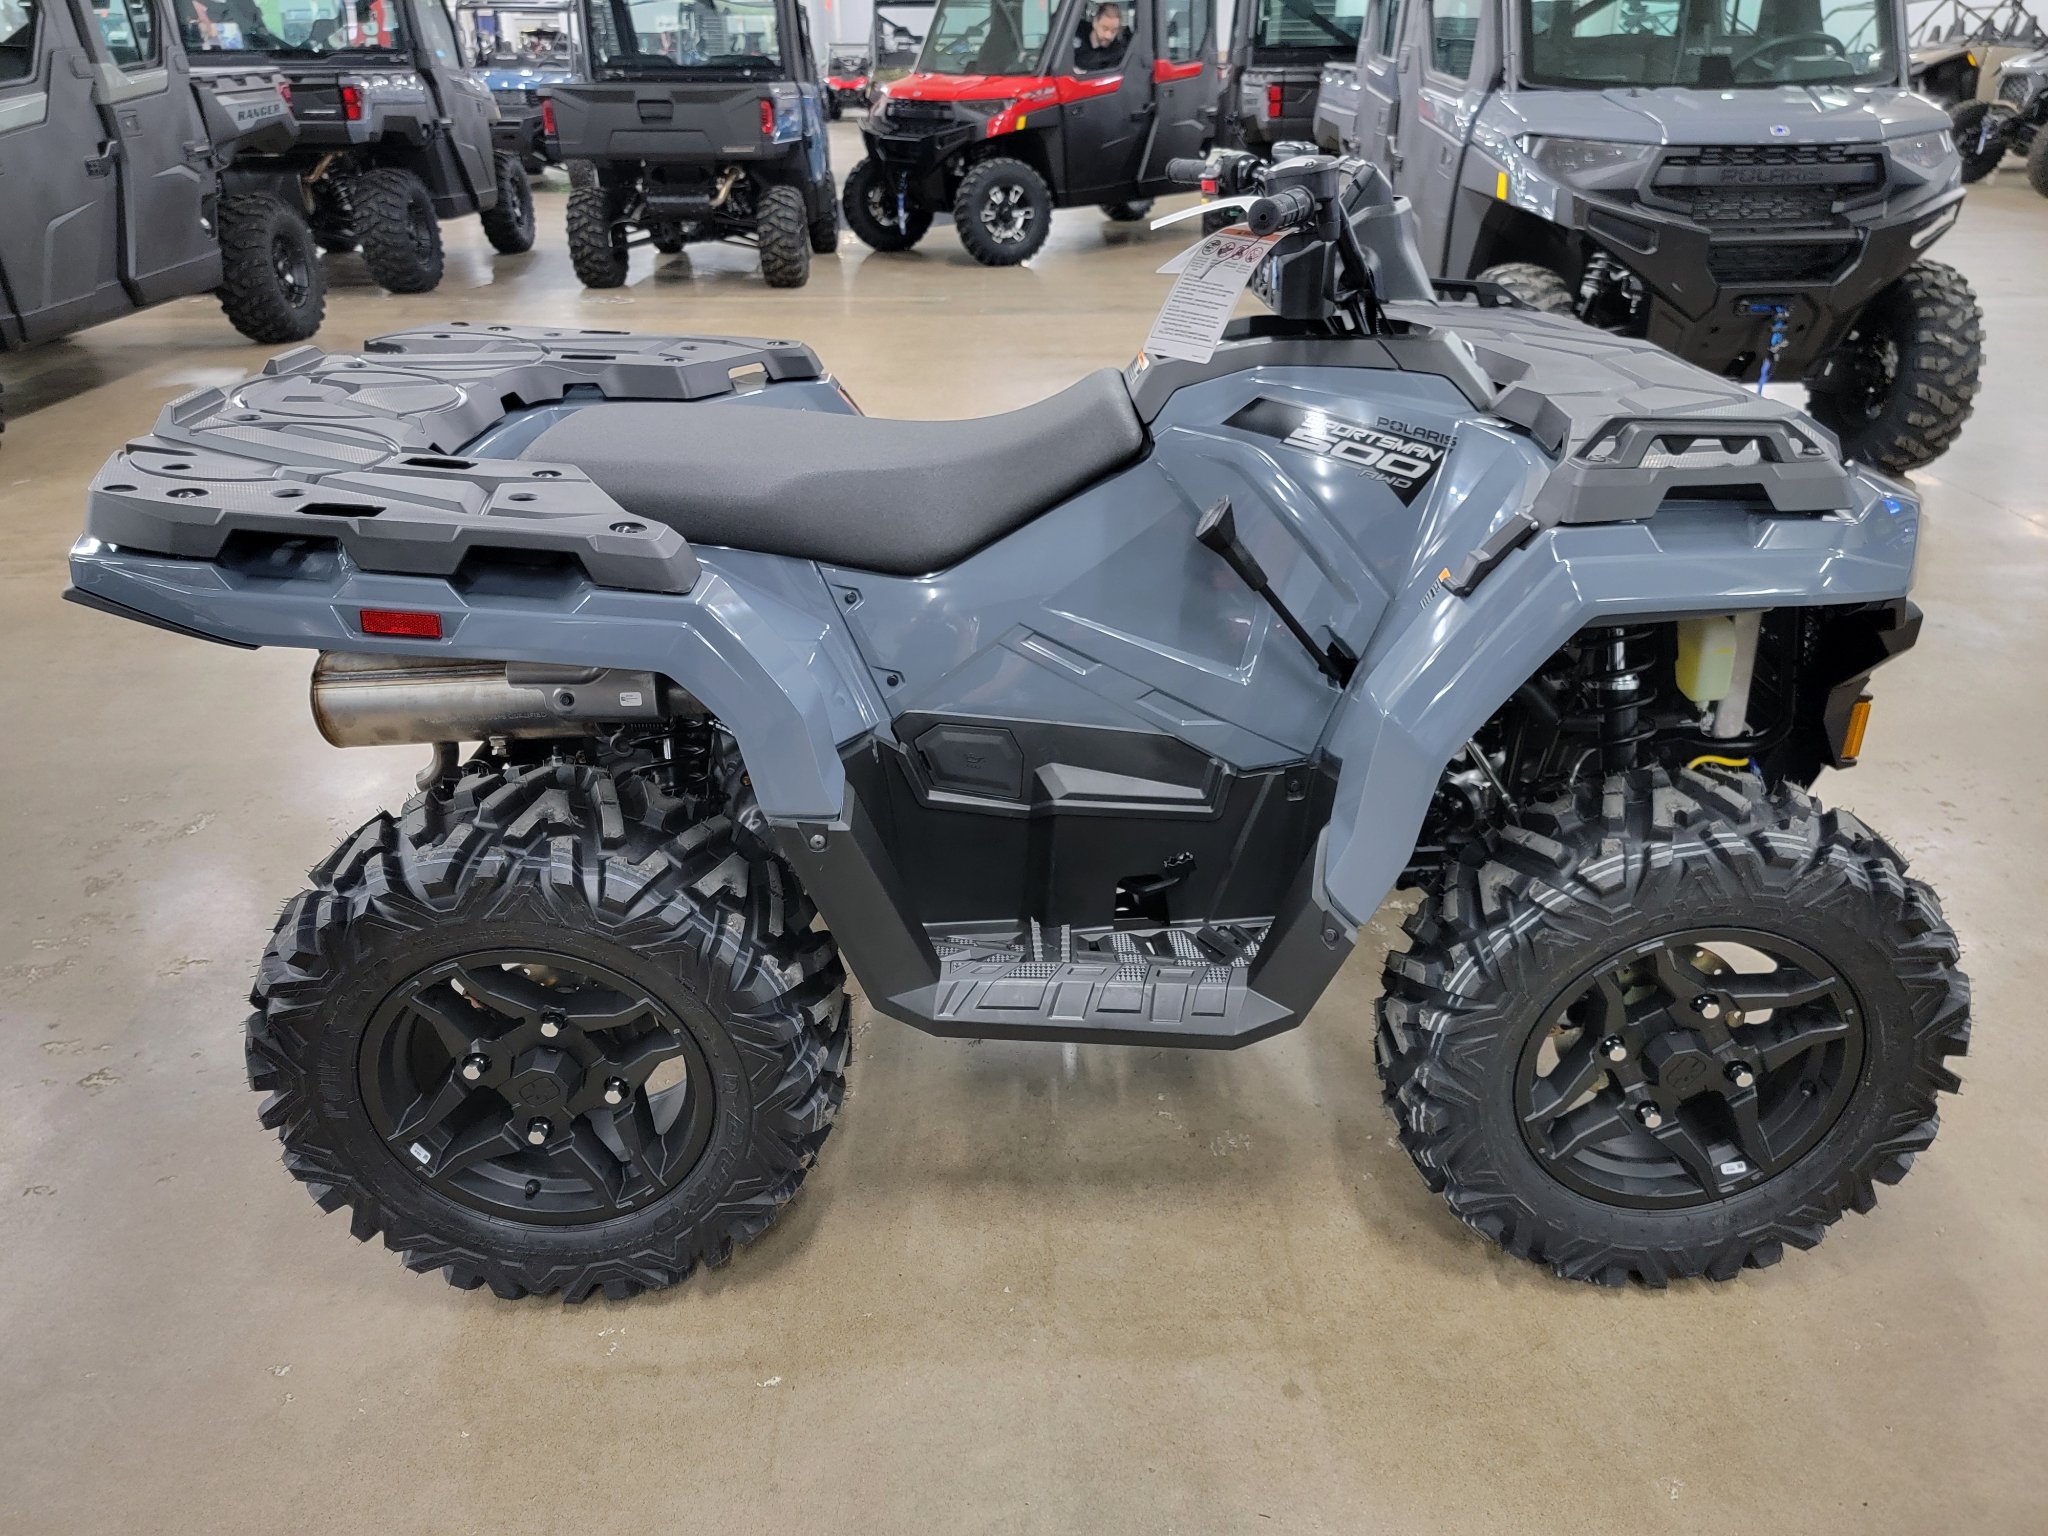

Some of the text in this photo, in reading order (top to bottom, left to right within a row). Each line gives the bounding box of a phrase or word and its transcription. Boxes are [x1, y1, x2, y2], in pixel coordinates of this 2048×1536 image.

[237, 104, 280, 121] RANGER
[1720, 168, 1823, 183] POLARIS
[1302, 411, 1444, 462] SPORTSMAN
[1376, 416, 1458, 448] POLARIS
[1283, 427, 1431, 479] 500
[1357, 469, 1413, 489] AWD
